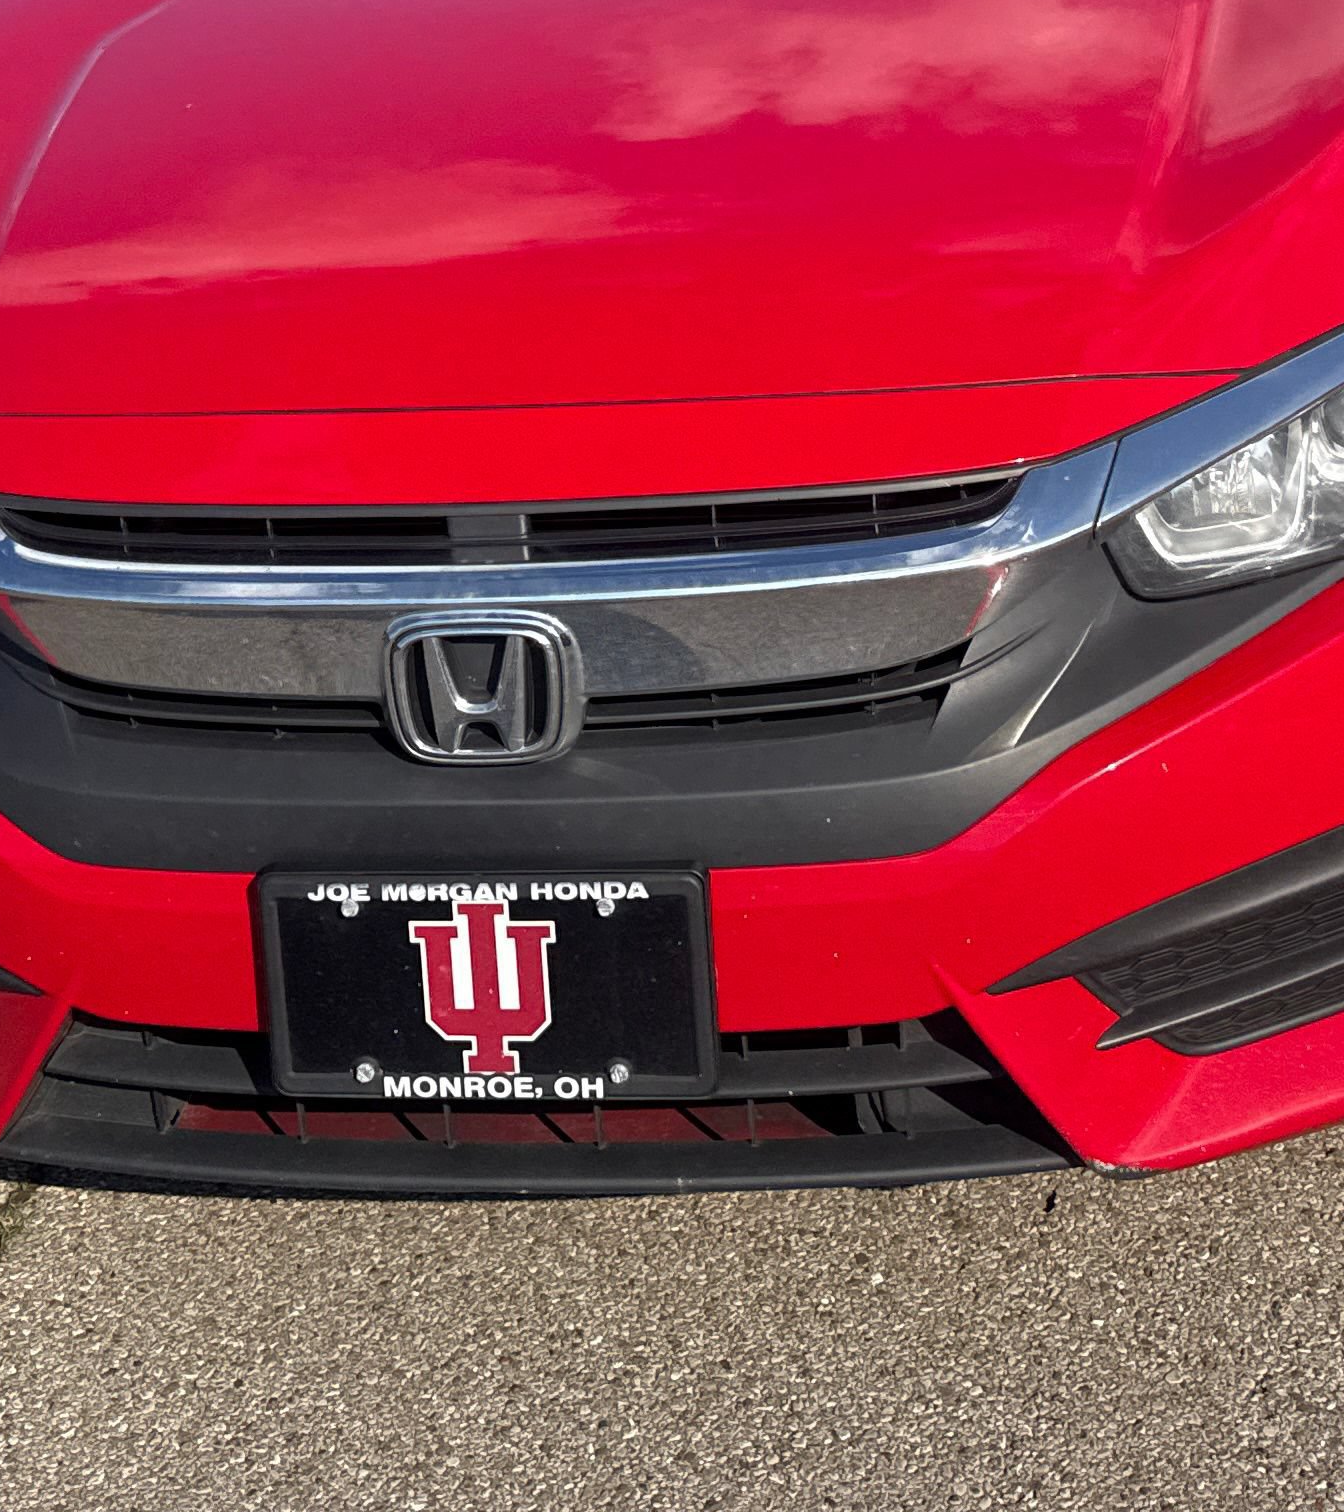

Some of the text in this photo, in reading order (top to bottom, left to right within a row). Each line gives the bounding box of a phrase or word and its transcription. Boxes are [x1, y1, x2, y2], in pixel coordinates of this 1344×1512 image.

[307, 881, 650, 902] JOE MORGAN HONDA
[383, 1076, 604, 1099] MONROE, OH
